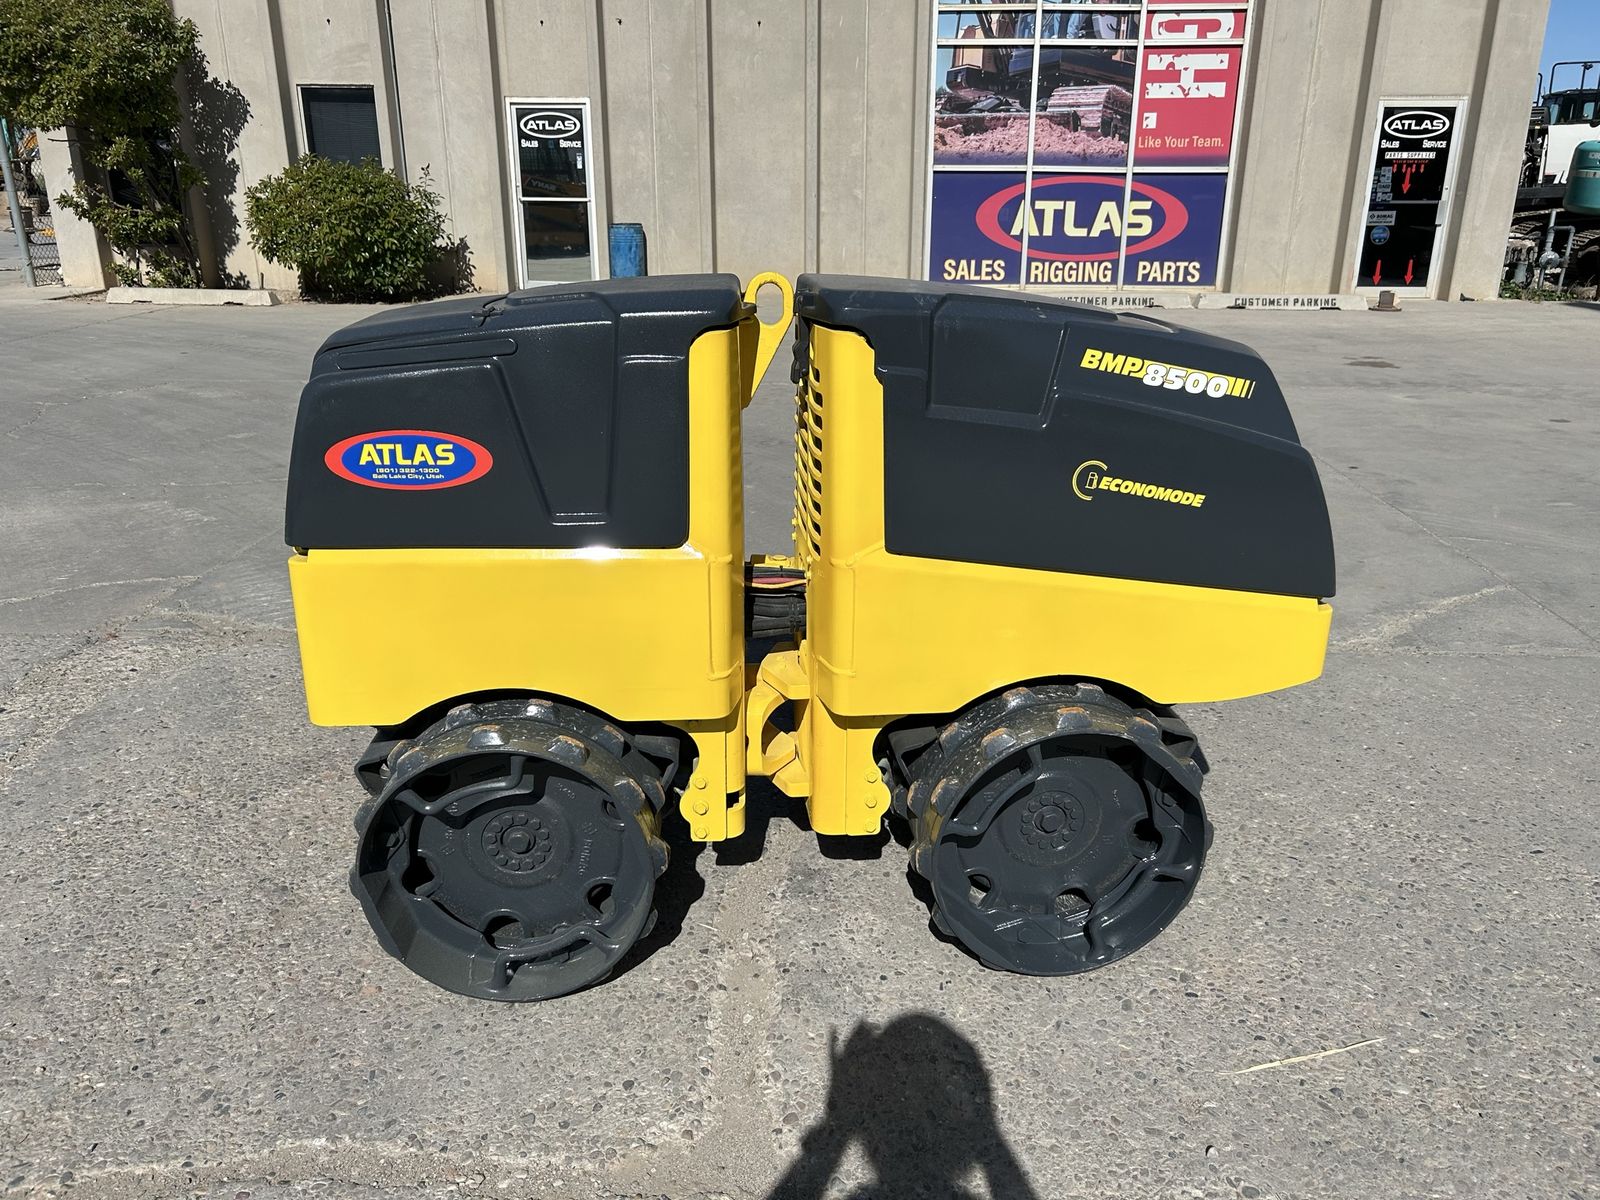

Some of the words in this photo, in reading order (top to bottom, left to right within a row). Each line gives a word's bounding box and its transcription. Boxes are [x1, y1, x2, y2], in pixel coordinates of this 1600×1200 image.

[527, 120, 575, 130] ATLAS
[1390, 119, 1444, 130] ATLAS
[521, 138, 538, 148] SALES
[559, 139, 582, 148] SERVICE
[1138, 136, 1161, 148] Like
[1164, 136, 1190, 148] Your
[1192, 136, 1224, 147] Team.
[1381, 139, 1400, 148] SALES
[1422, 139, 1447, 148] SERVICE
[1010, 199, 1153, 237] ATLAS
[943, 259, 1005, 281] SALES
[1030, 261, 1112, 283] RIGGING
[1137, 261, 1200, 283] PARTS
[1059, 296, 1107, 306] TOMER
[1111, 297, 1155, 306] PARKING
[1234, 297, 1289, 307] CUSTOMER
[1293, 297, 1337, 307] PARKING
[359, 443, 455, 465] ATLAS
[1098, 477, 1206, 508] ECONOMODE
